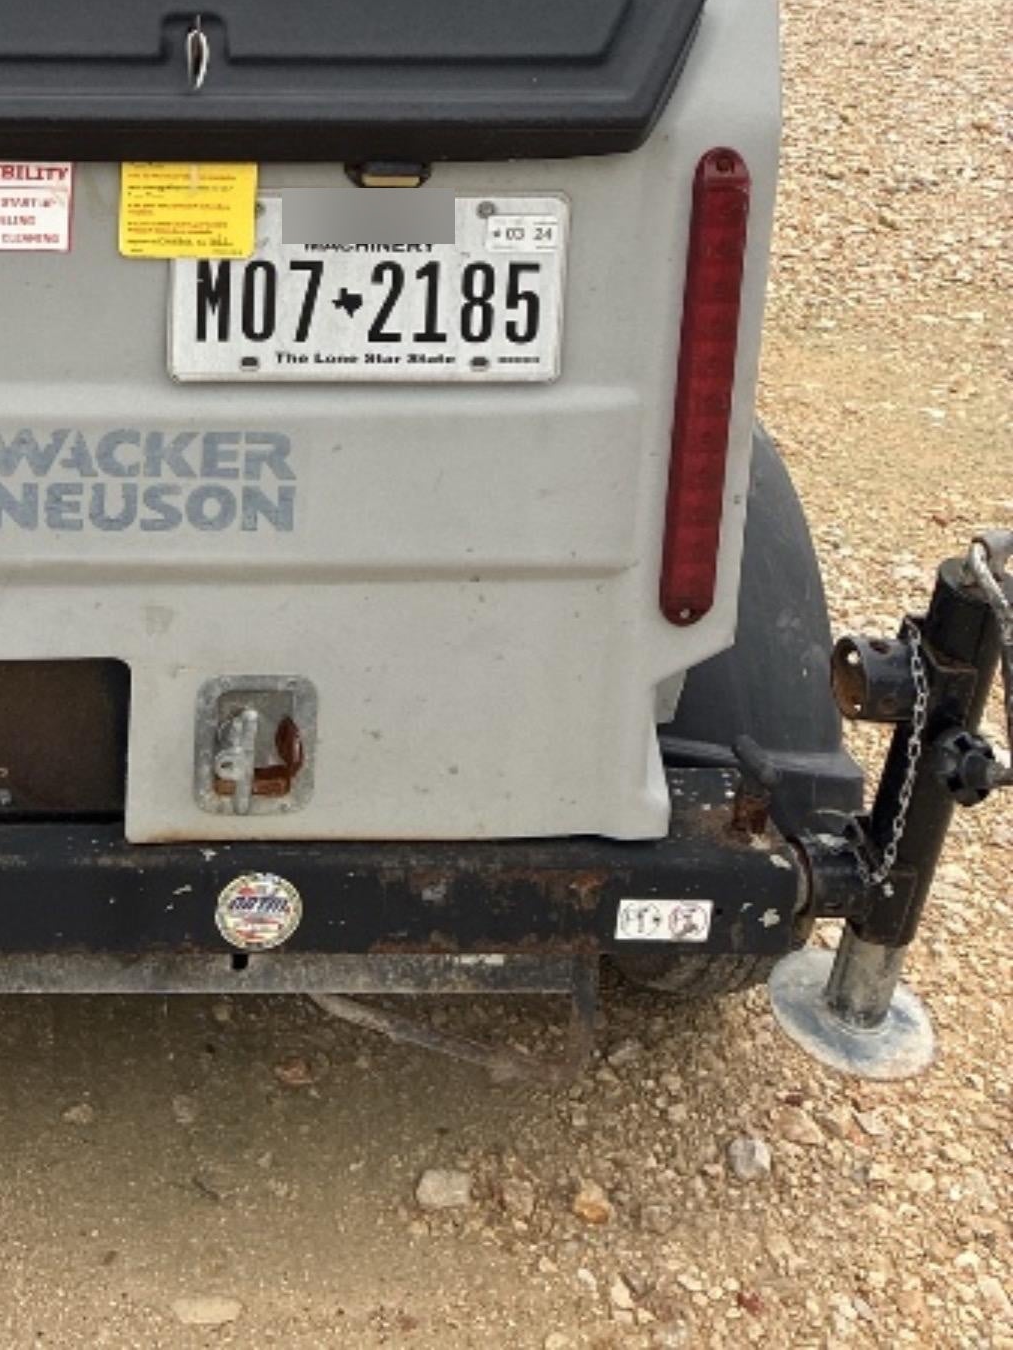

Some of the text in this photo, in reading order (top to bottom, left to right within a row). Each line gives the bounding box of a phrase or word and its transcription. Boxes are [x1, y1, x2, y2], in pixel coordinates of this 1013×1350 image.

[195, 258, 542, 345] M07 2185
[276, 352, 457, 366] The Lone Star State
